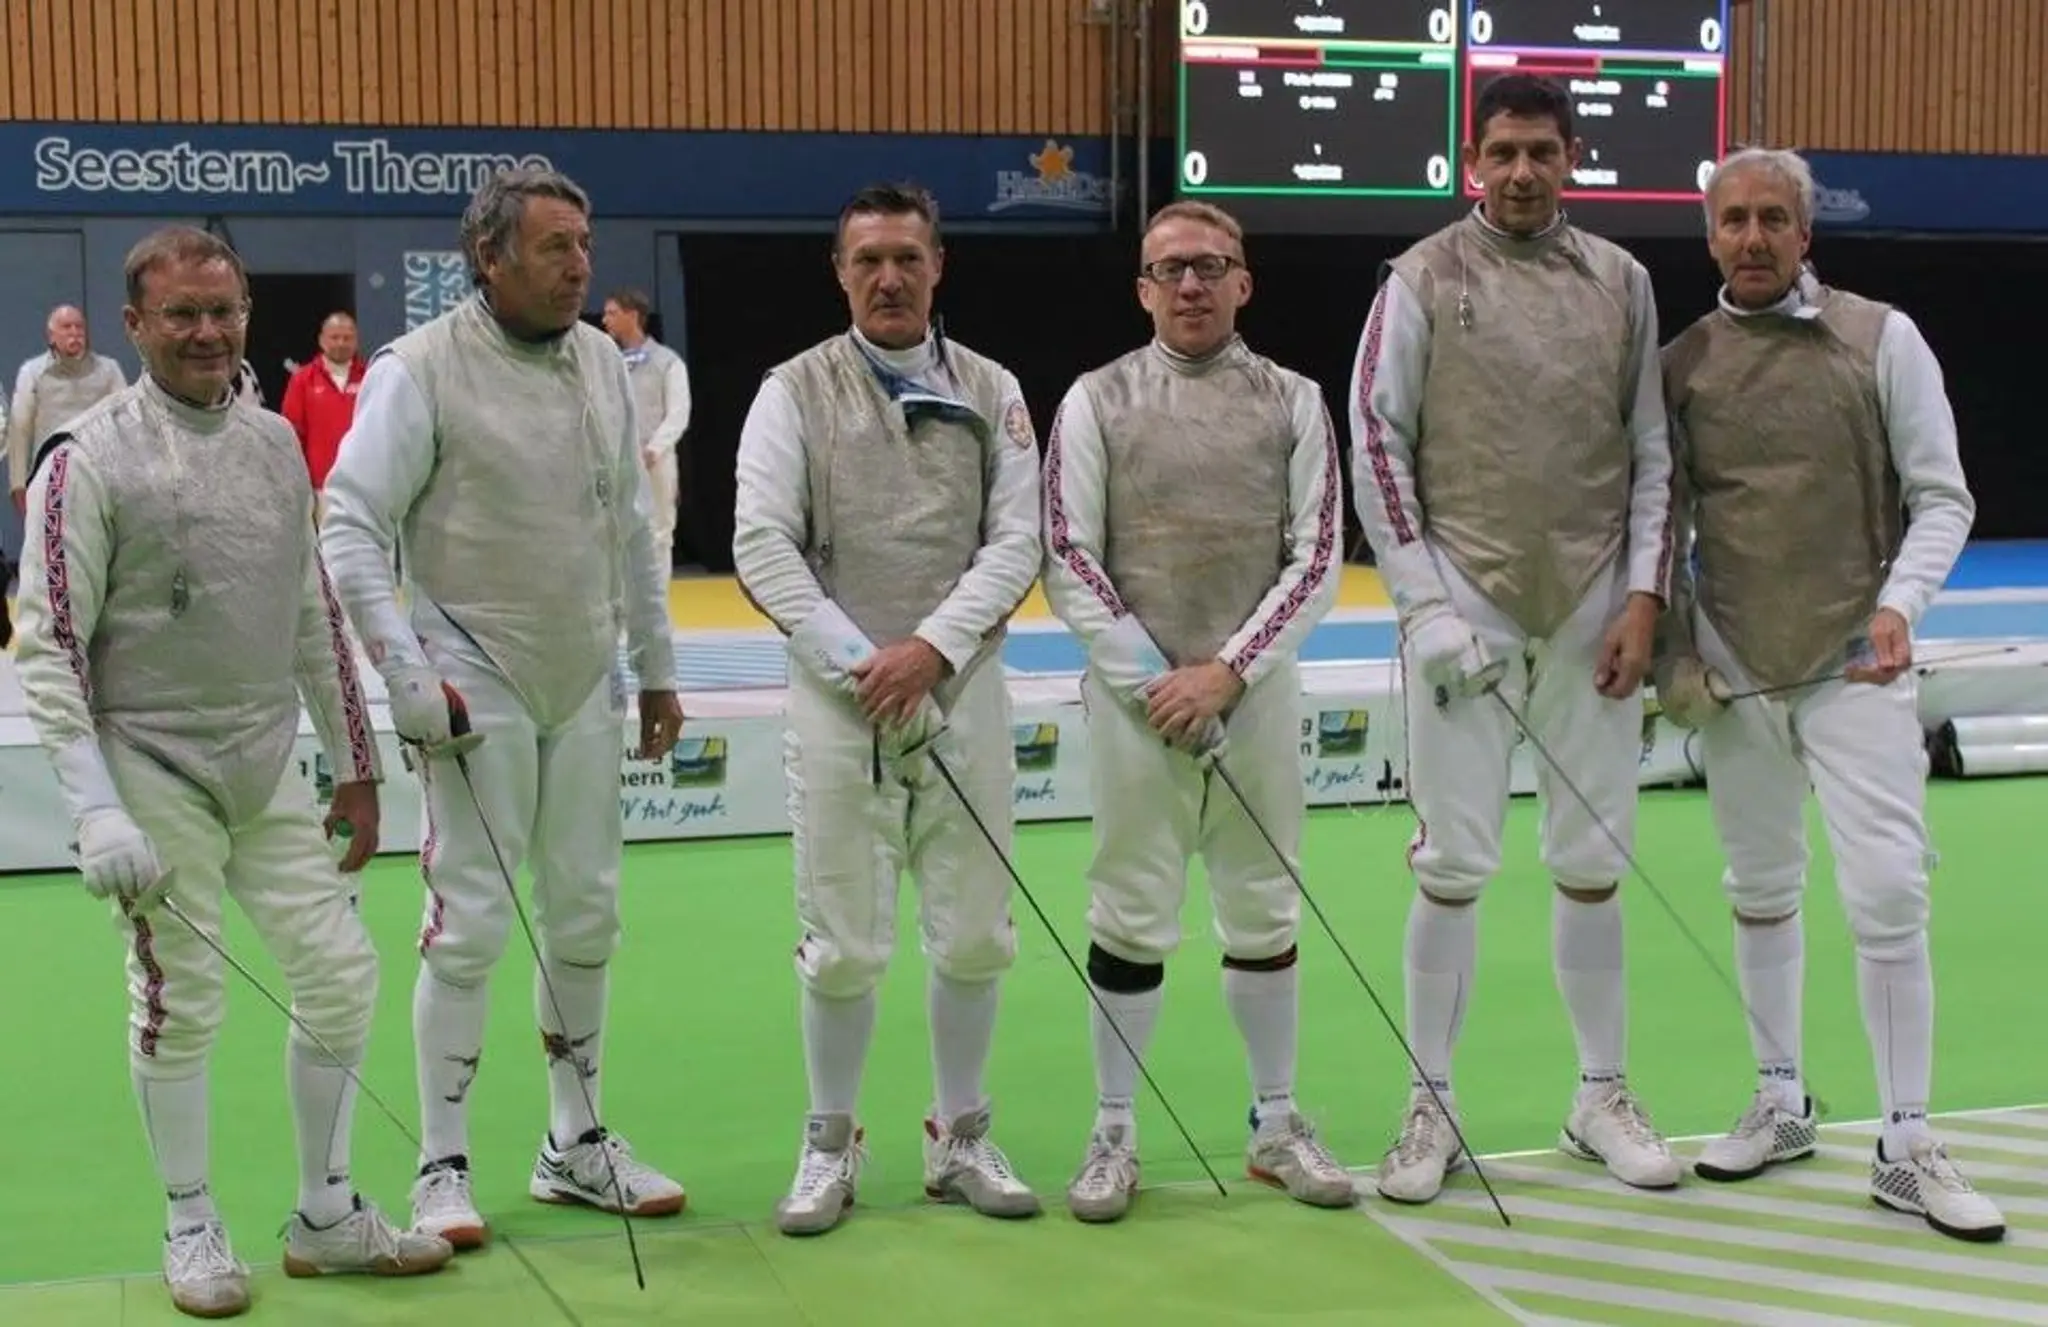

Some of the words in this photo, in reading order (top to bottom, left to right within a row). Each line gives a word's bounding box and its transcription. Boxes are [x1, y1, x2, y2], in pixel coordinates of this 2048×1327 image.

[1186, 1, 1209, 35] 0
[1429, 8, 1450, 42] 0
[1471, 10, 1493, 44] 0
[1700, 17, 1721, 51] 0
[1184, 150, 1208, 185] 0
[1427, 155, 1450, 189] 0
